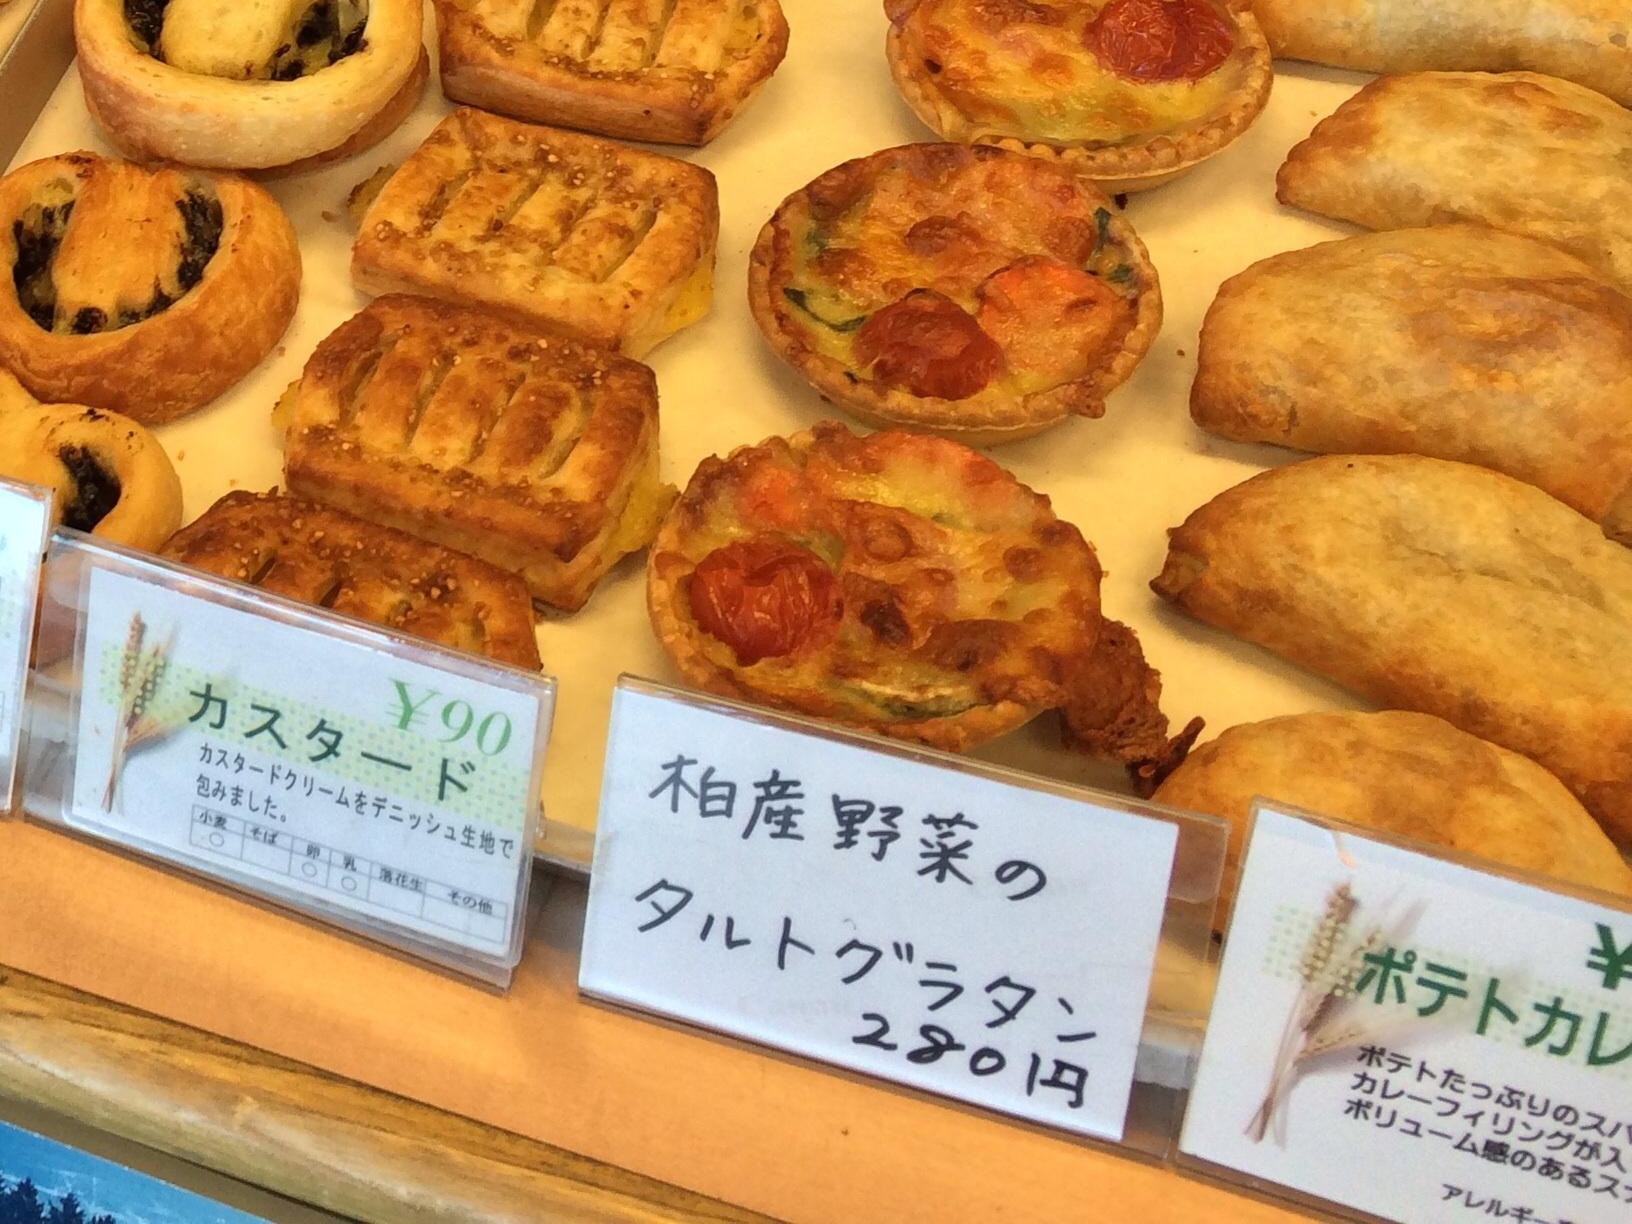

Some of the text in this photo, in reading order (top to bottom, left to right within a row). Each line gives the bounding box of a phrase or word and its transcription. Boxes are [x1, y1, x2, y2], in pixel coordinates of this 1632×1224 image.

[187, 682, 477, 801] カスタード
[385, 678, 513, 757] ¥90
[196, 774, 288, 824] 包みました。
[199, 742, 515, 860] カスタードクリームをデニッシュ生地で
[649, 753, 1048, 902] 柏産野菜の
[199, 810, 228, 831] 小麦
[249, 827, 279, 846] そば
[306, 841, 321, 860] 卵
[343, 855, 358, 873] 乳
[448, 888, 493, 915] その他
[634, 878, 1098, 1043] タルトグラタン
[1356, 945, 1632, 1066] ポテトカレ
[851, 1011, 1089, 1109] 280円
[1350, 1071, 1627, 1173] カレーフィリングが入
[1442, 1183, 1574, 1224] アレルギー
